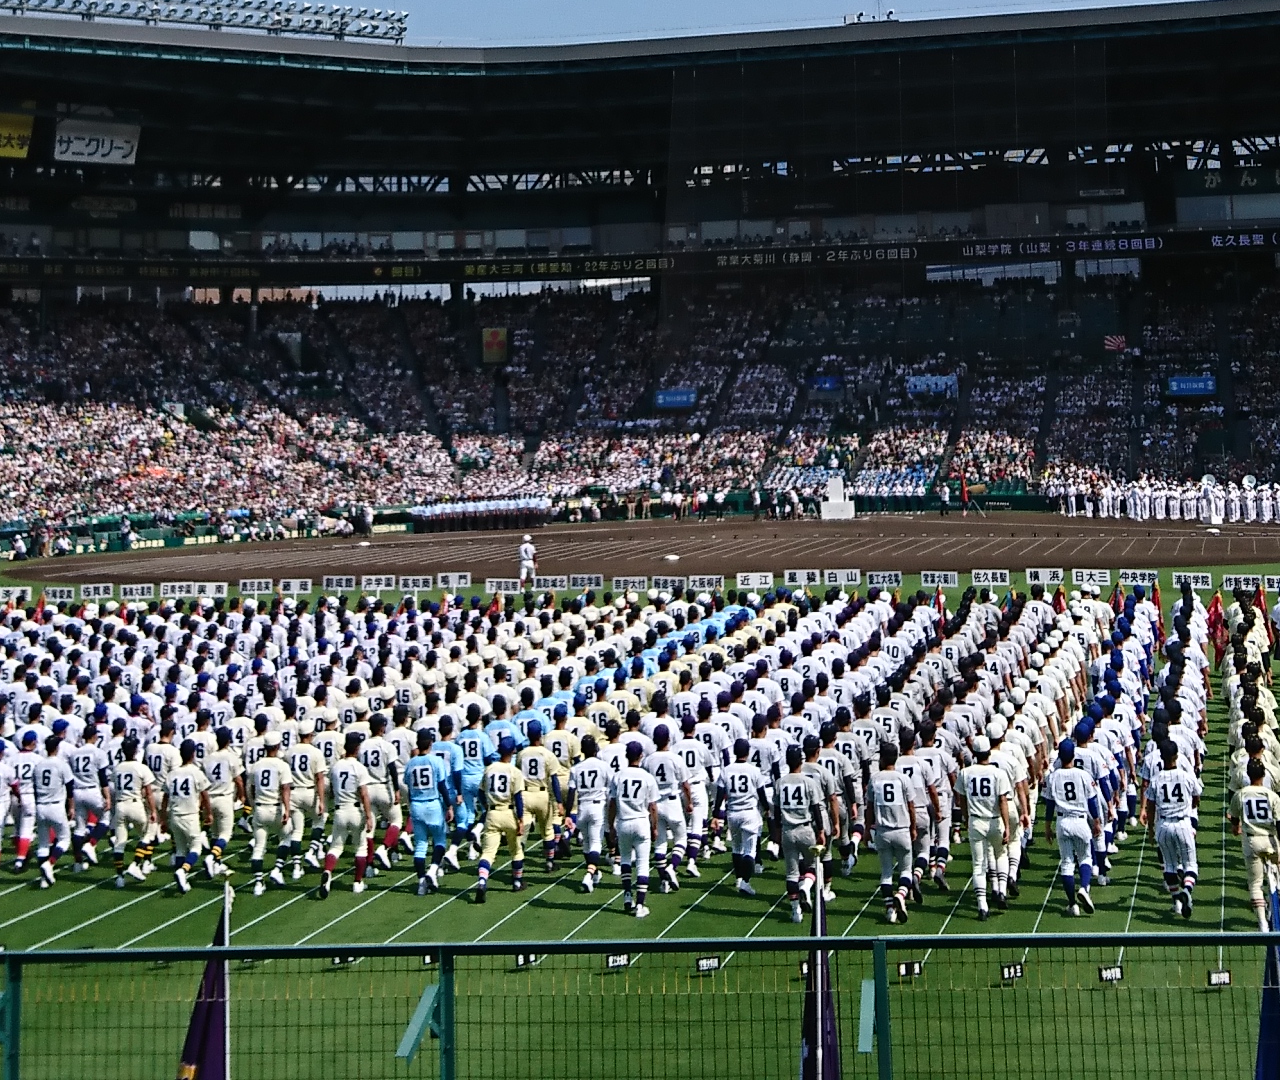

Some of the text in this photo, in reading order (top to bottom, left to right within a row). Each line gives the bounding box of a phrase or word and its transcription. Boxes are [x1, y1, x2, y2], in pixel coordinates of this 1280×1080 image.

[57, 135, 135, 160] サニクリーン
[439, 574, 468, 586] 鳴門
[572, 576, 602, 588] 創志学園
[740, 575, 770, 586] 近江
[788, 572, 818, 584] 星稜
[827, 572, 857, 583] 白山
[973, 572, 1007, 583] 佐久長聖
[1029, 570, 1060, 582] 横浜
[1075, 571, 1108, 583] 日大三
[1122, 571, 1157, 584] 中央学院
[1225, 576, 1261, 589] 作新学院
[82, 585, 113, 597] 佐賀商
[1032, 607, 1038, 616] 9
[239, 641, 244, 651] 3
[886, 645, 899, 657] 10
[947, 648, 953, 660] 6
[803, 665, 810, 678] 2
[247, 685, 254, 697] 5
[781, 678, 788, 692] 8
[396, 689, 409, 703] 15
[676, 703, 690, 716] 15
[592, 713, 606, 728] 16
[108, 749, 123, 765] 14
[553, 742, 561, 757] 6
[75, 757, 90, 773] 12
[149, 756, 161, 772] 10
[291, 755, 307, 771] 18
[364, 750, 380, 767] 13
[611, 756, 619, 772] 4
[15, 764, 31, 780] 12
[212, 763, 221, 779] 4
[529, 759, 538, 776] 8
[656, 764, 666, 781] 4
[903, 768, 913, 779] 7
[43, 770, 51, 786] 6
[118, 774, 133, 790] 12
[261, 770, 271, 786] 8
[340, 772, 349, 789] 7
[412, 768, 430, 786] 15
[491, 775, 507, 792] 13
[580, 771, 597, 789] 17
[730, 775, 748, 792] 13
[173, 779, 189, 795] 14
[623, 781, 641, 798] 17
[884, 784, 894, 802] 6
[971, 778, 991, 796] 16
[1064, 782, 1076, 800] 8
[1162, 784, 1184, 802] 14
[782, 787, 803, 805] 14
[1246, 800, 1268, 819] 15
